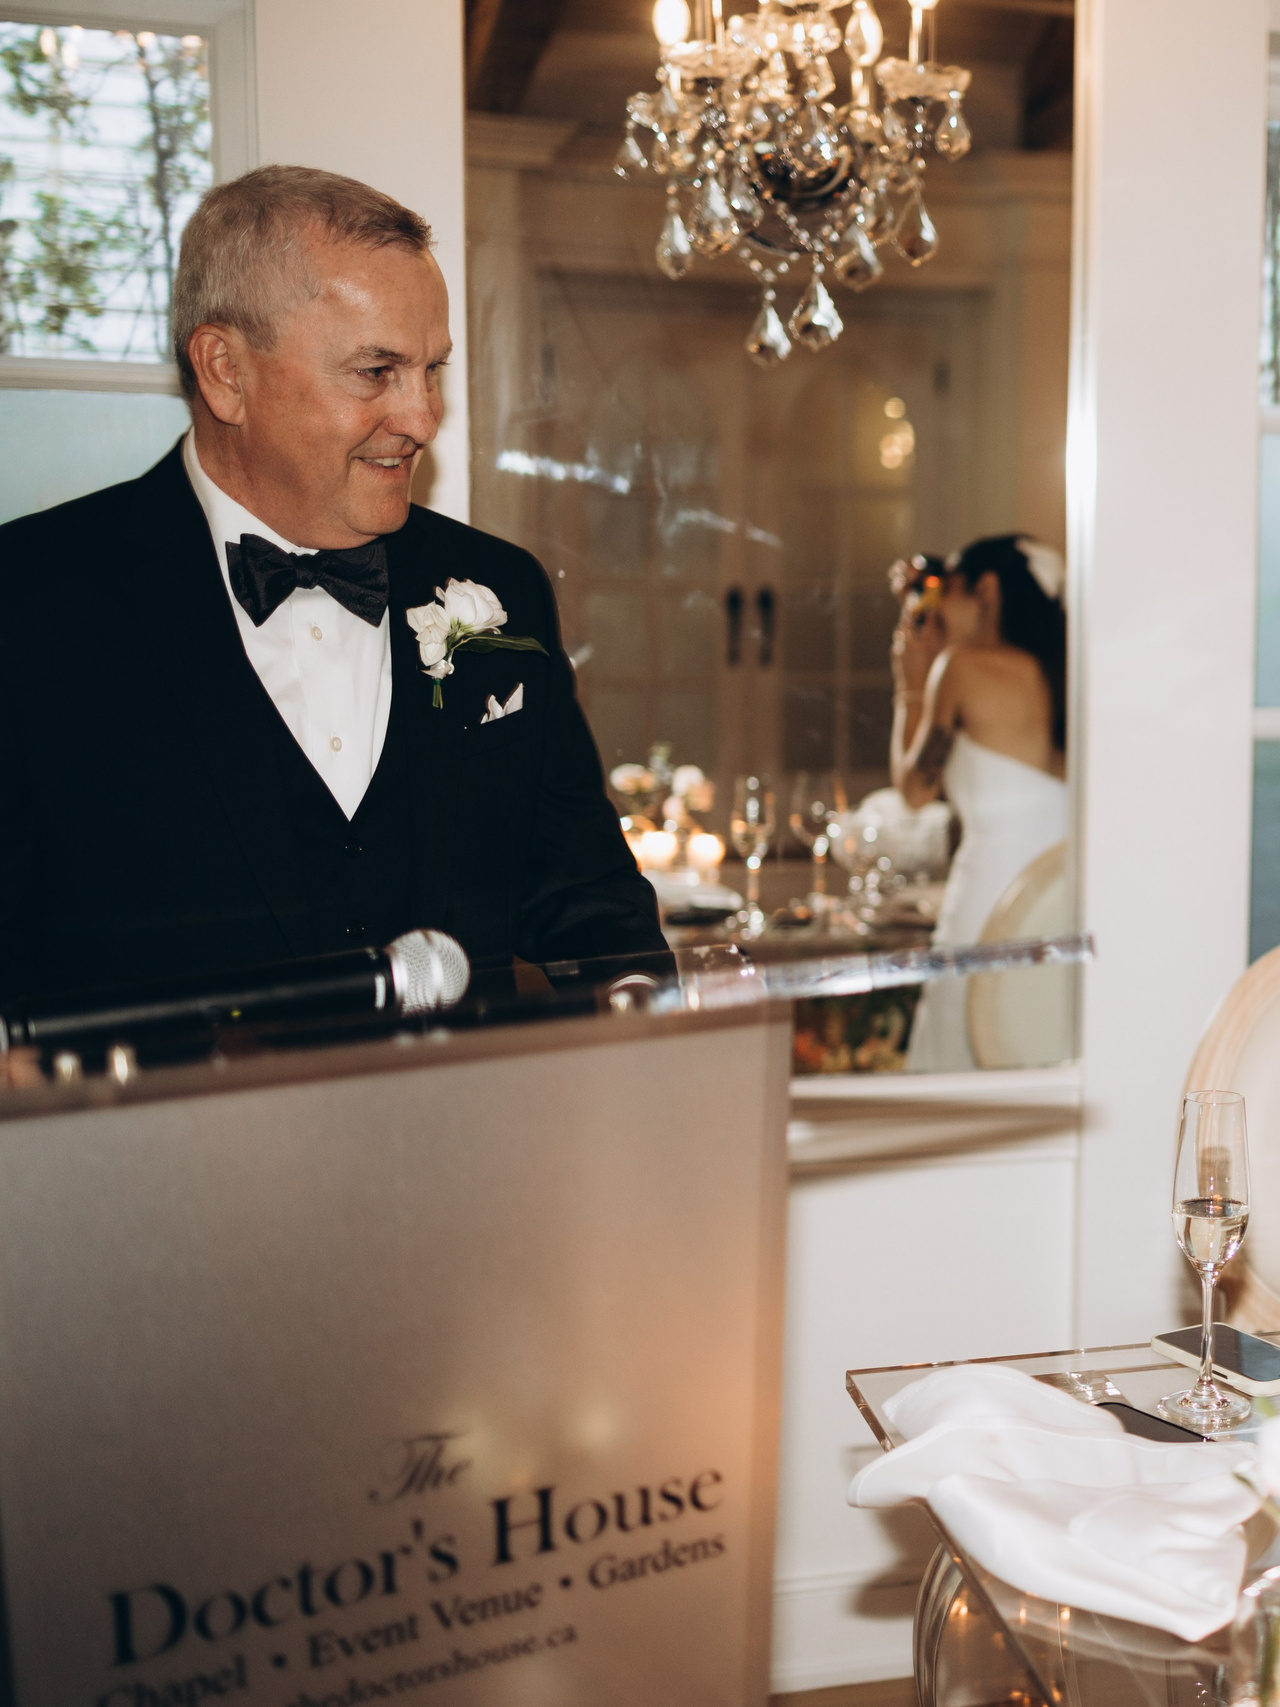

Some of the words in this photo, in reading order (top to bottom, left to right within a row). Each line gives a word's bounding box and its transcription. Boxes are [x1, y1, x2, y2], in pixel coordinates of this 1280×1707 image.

[367, 1430, 473, 1503] The
[107, 1517, 462, 1669] Doctor's
[488, 1466, 725, 1568] House
[306, 1613, 421, 1670] Event
[429, 1581, 544, 1632] Venue
[586, 1533, 727, 1591] Gardens
